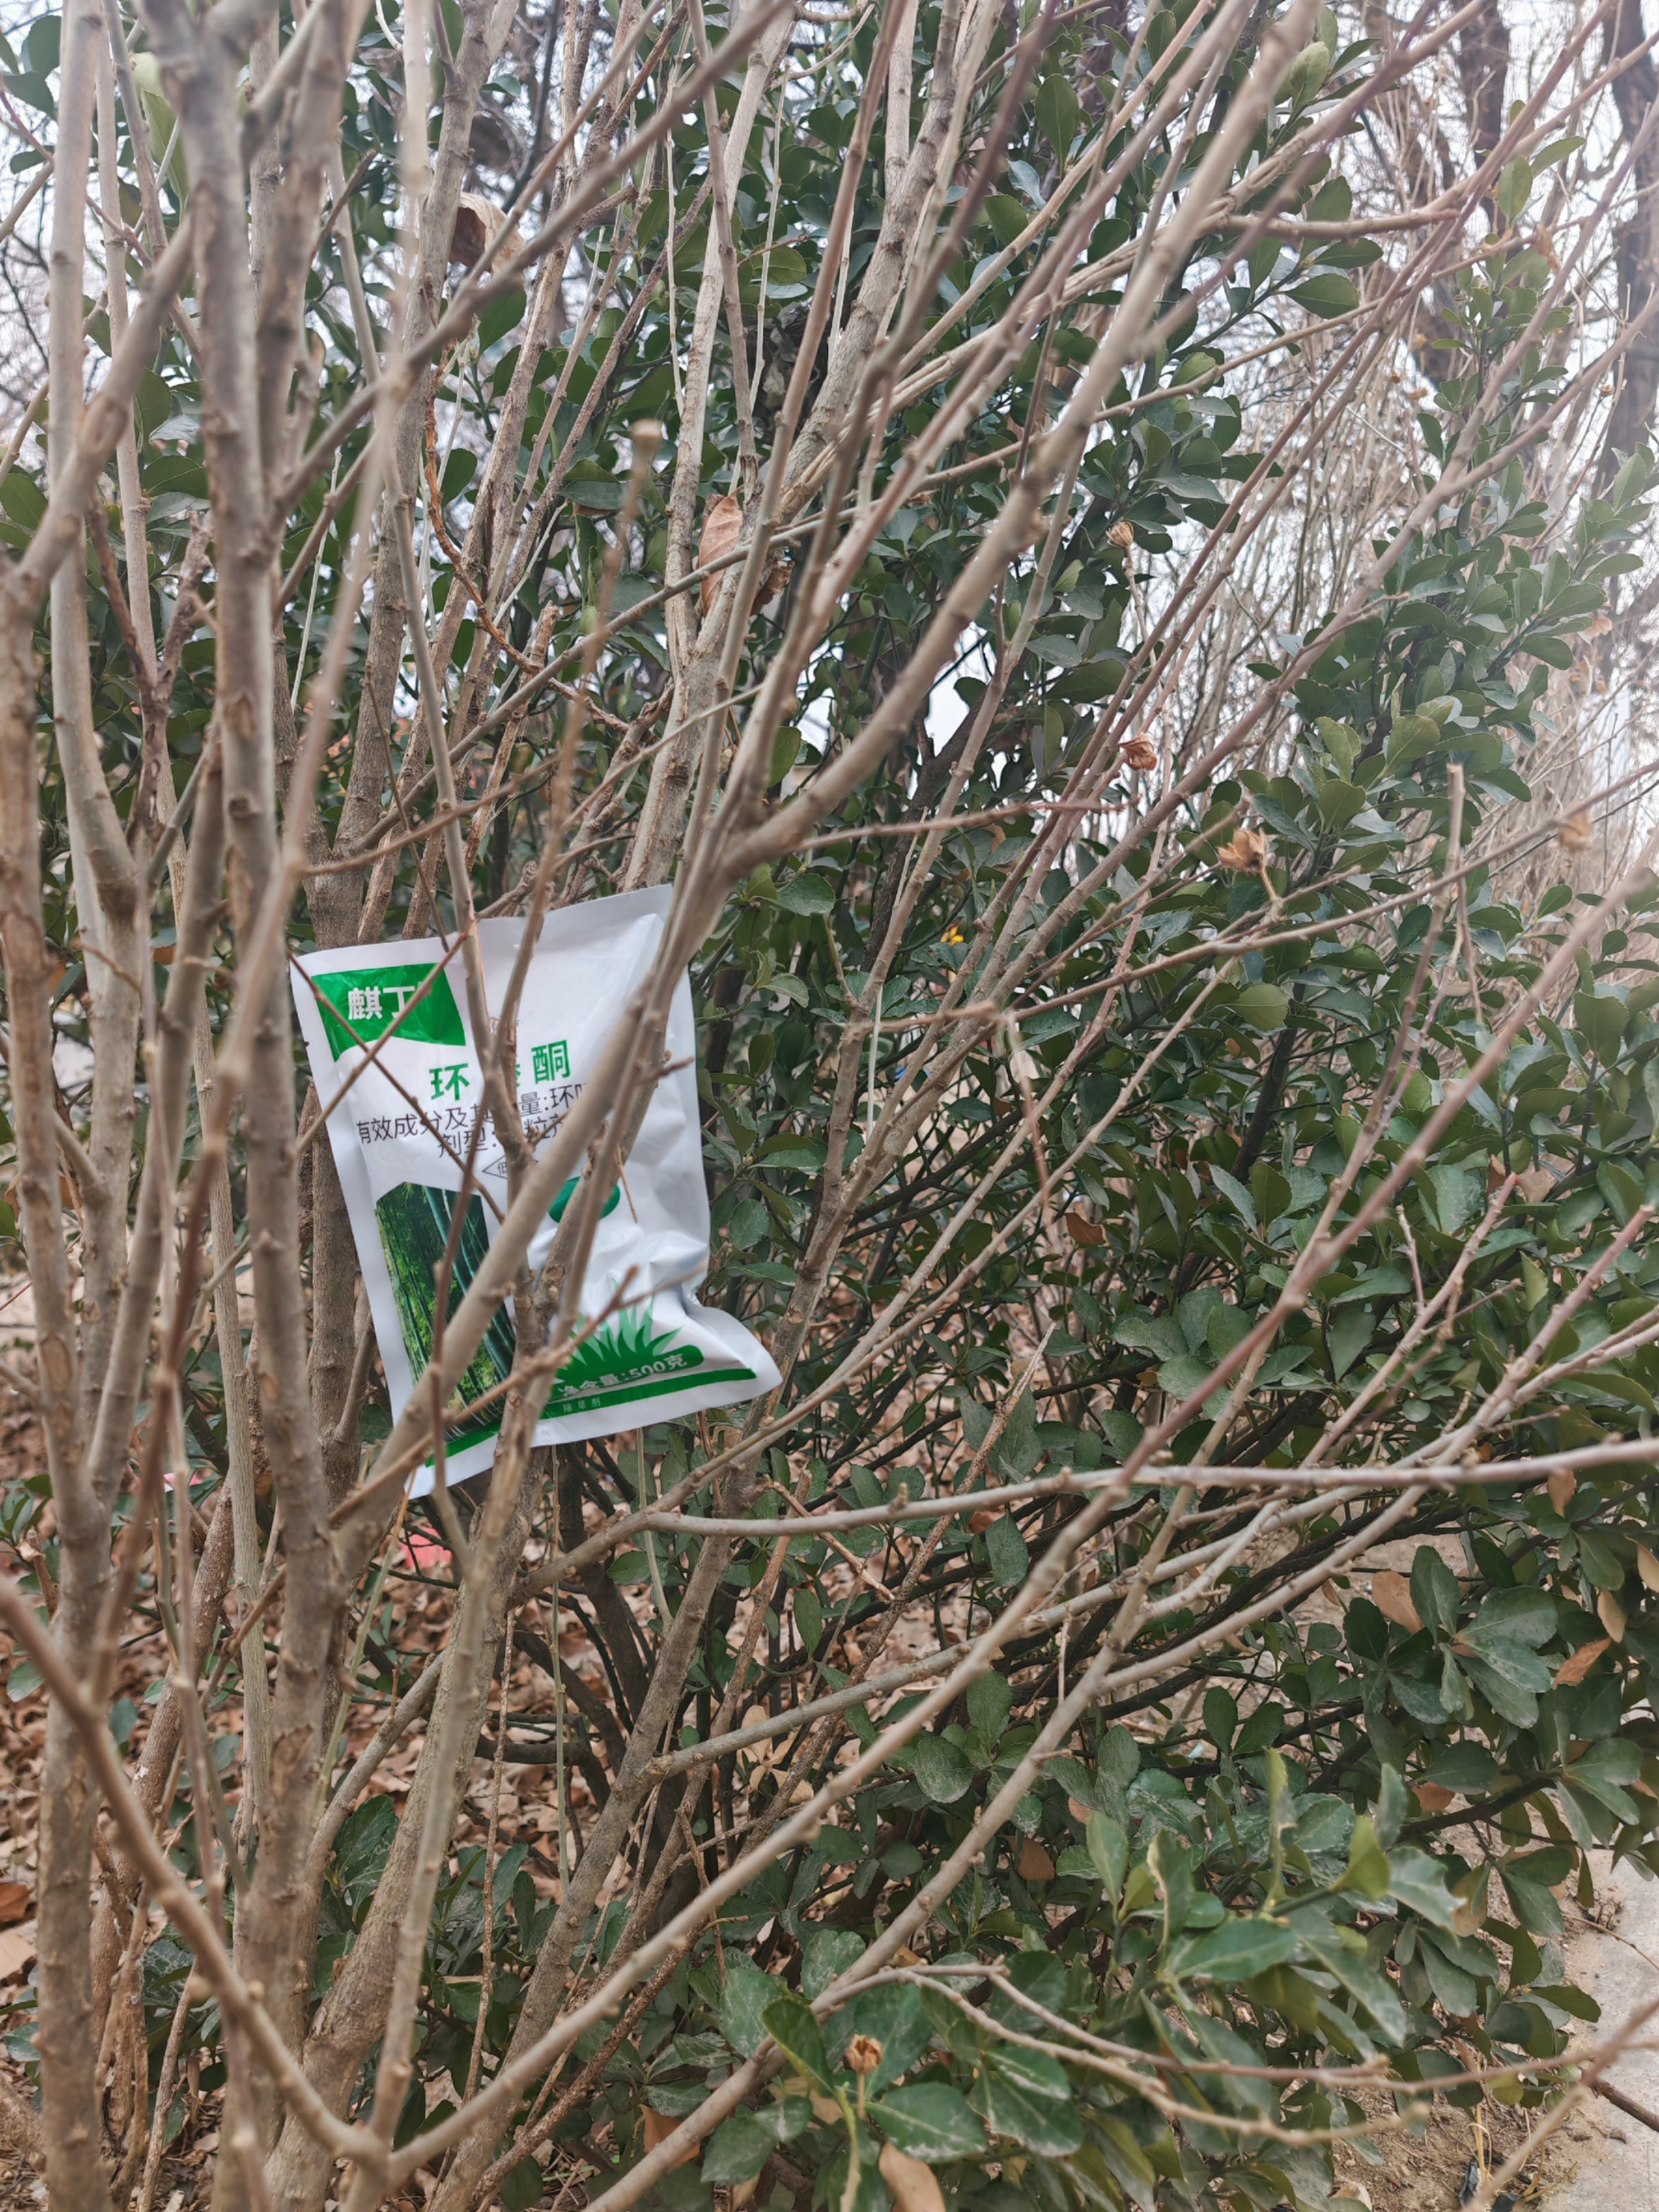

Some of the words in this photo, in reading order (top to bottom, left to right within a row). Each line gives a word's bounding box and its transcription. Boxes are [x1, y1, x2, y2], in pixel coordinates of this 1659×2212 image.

[429, 1040, 571, 1101] 环酮
[357, 1083, 586, 1144] 有效成分及其量:环
